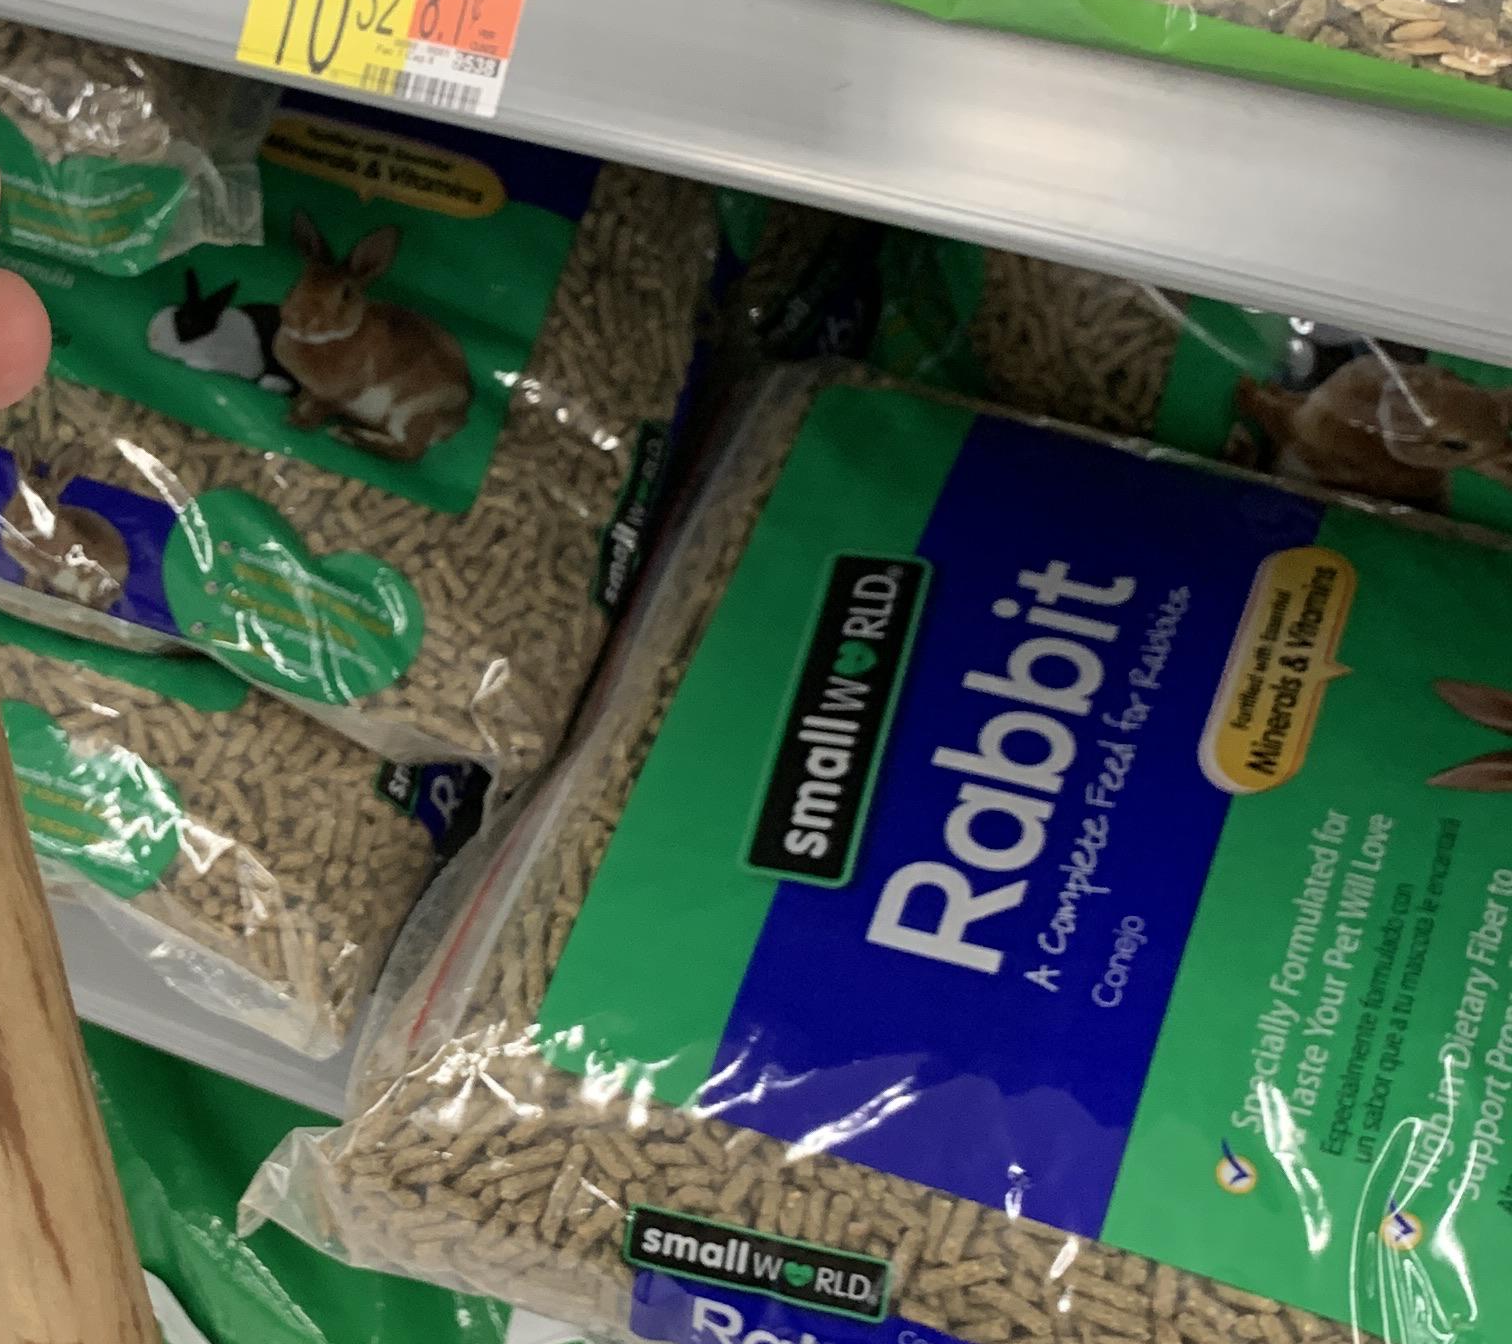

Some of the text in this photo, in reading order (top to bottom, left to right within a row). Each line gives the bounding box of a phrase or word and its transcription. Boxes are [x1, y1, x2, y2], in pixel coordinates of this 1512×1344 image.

[1245, 564, 1338, 775] Minerals & Vitamins
[865, 560, 1136, 975] Rabbit
[1023, 586, 1190, 993] A Complete Feed for Rabbits
[1350, 812, 1394, 872] Love
[1336, 871, 1377, 920] Will
[1391, 881, 1415, 915] con
[1091, 915, 1148, 1008] Conejo
[1231, 808, 1352, 1134] Specially Formulated for
[1322, 922, 1365, 971] Pet
[1302, 973, 1349, 1037] Your
[1403, 868, 1512, 1189] High in Dietary Fiber to
[1289, 1042, 1330, 1117] Taste
[1379, 1029, 1406, 1071] que
[1362, 1075, 1394, 1133] sabor
[1447, 1075, 1512, 1202] Support
[1354, 1135, 1375, 1165] un
